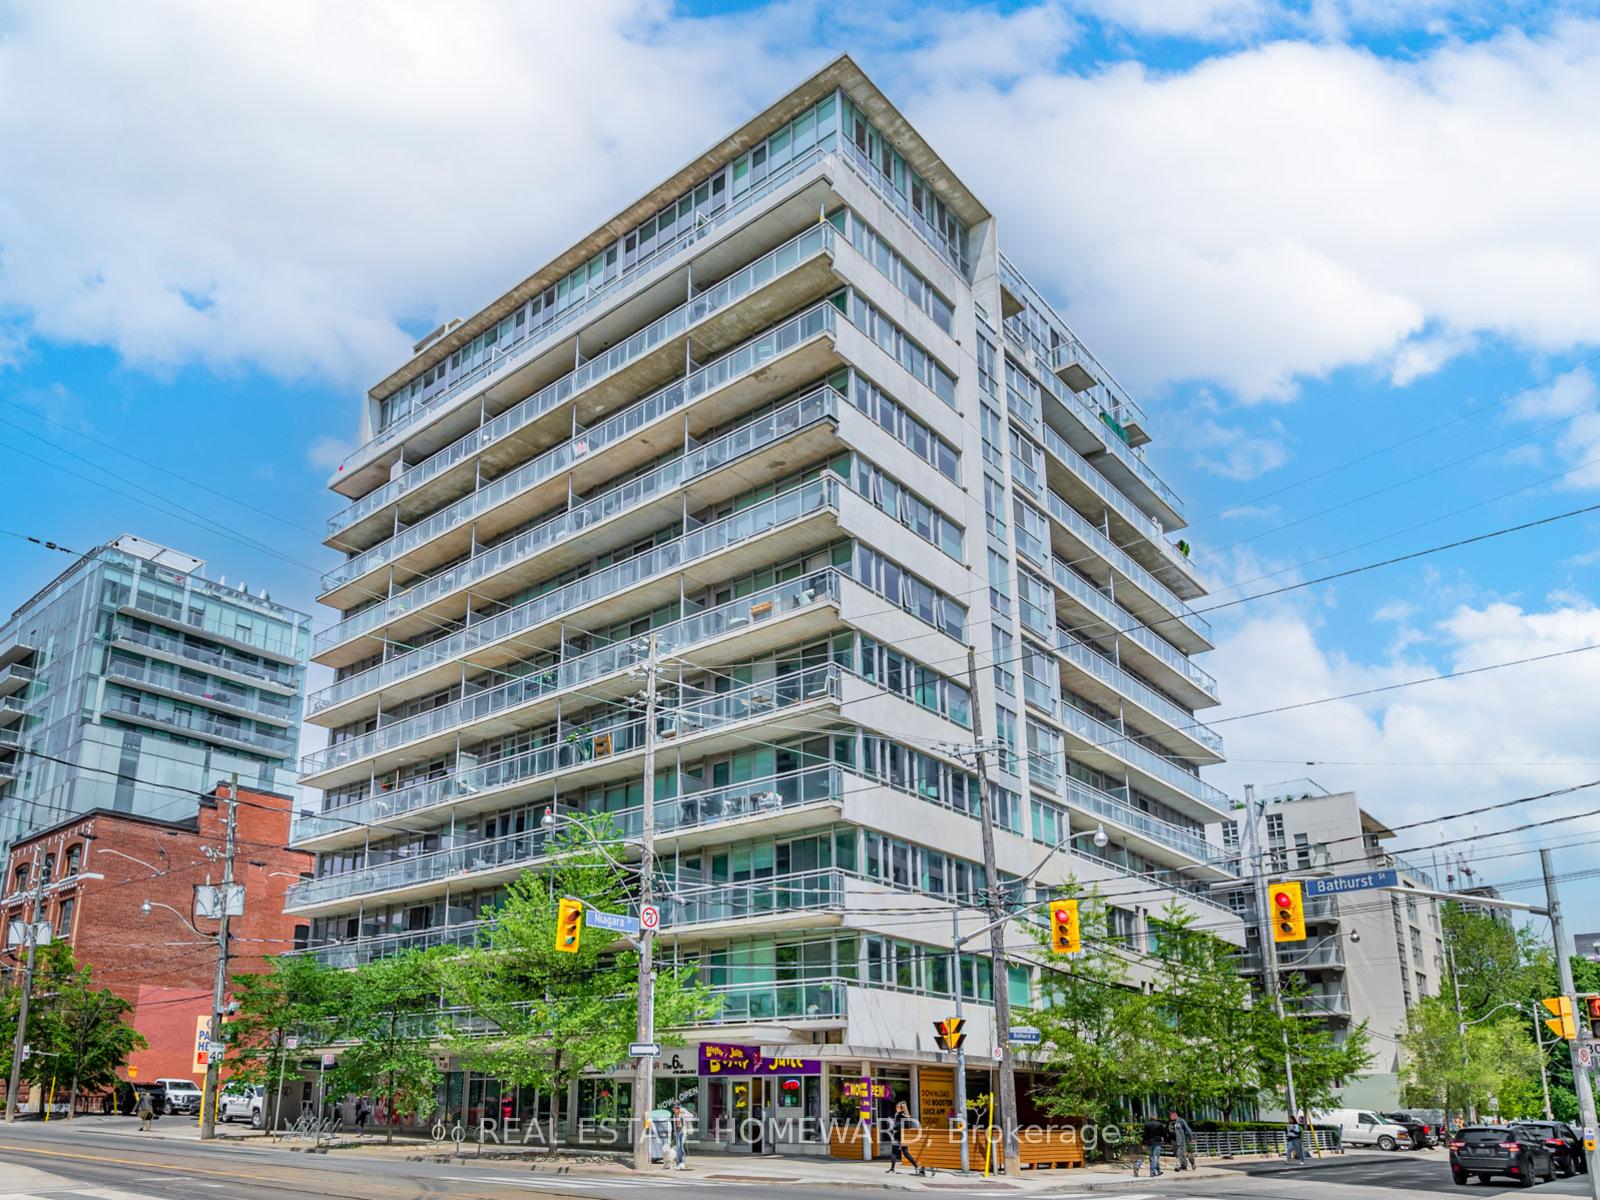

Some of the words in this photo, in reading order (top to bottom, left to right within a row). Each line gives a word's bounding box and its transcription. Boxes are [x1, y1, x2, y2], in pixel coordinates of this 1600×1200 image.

[1317, 874, 1374, 892] Bathurst
[1377, 872, 1386, 880] St
[595, 912, 624, 927] Niagara
[210, 1052, 224, 1061] 40
[663, 1062, 672, 1070] The
[657, 1096, 674, 1110] NOW
[679, 1087, 698, 1101] OPEN
[922, 1099, 932, 1107] THE
[932, 1099, 954, 1107] BOOSTER
[922, 1108, 937, 1116] JUICE
[937, 1108, 947, 1116] APP
